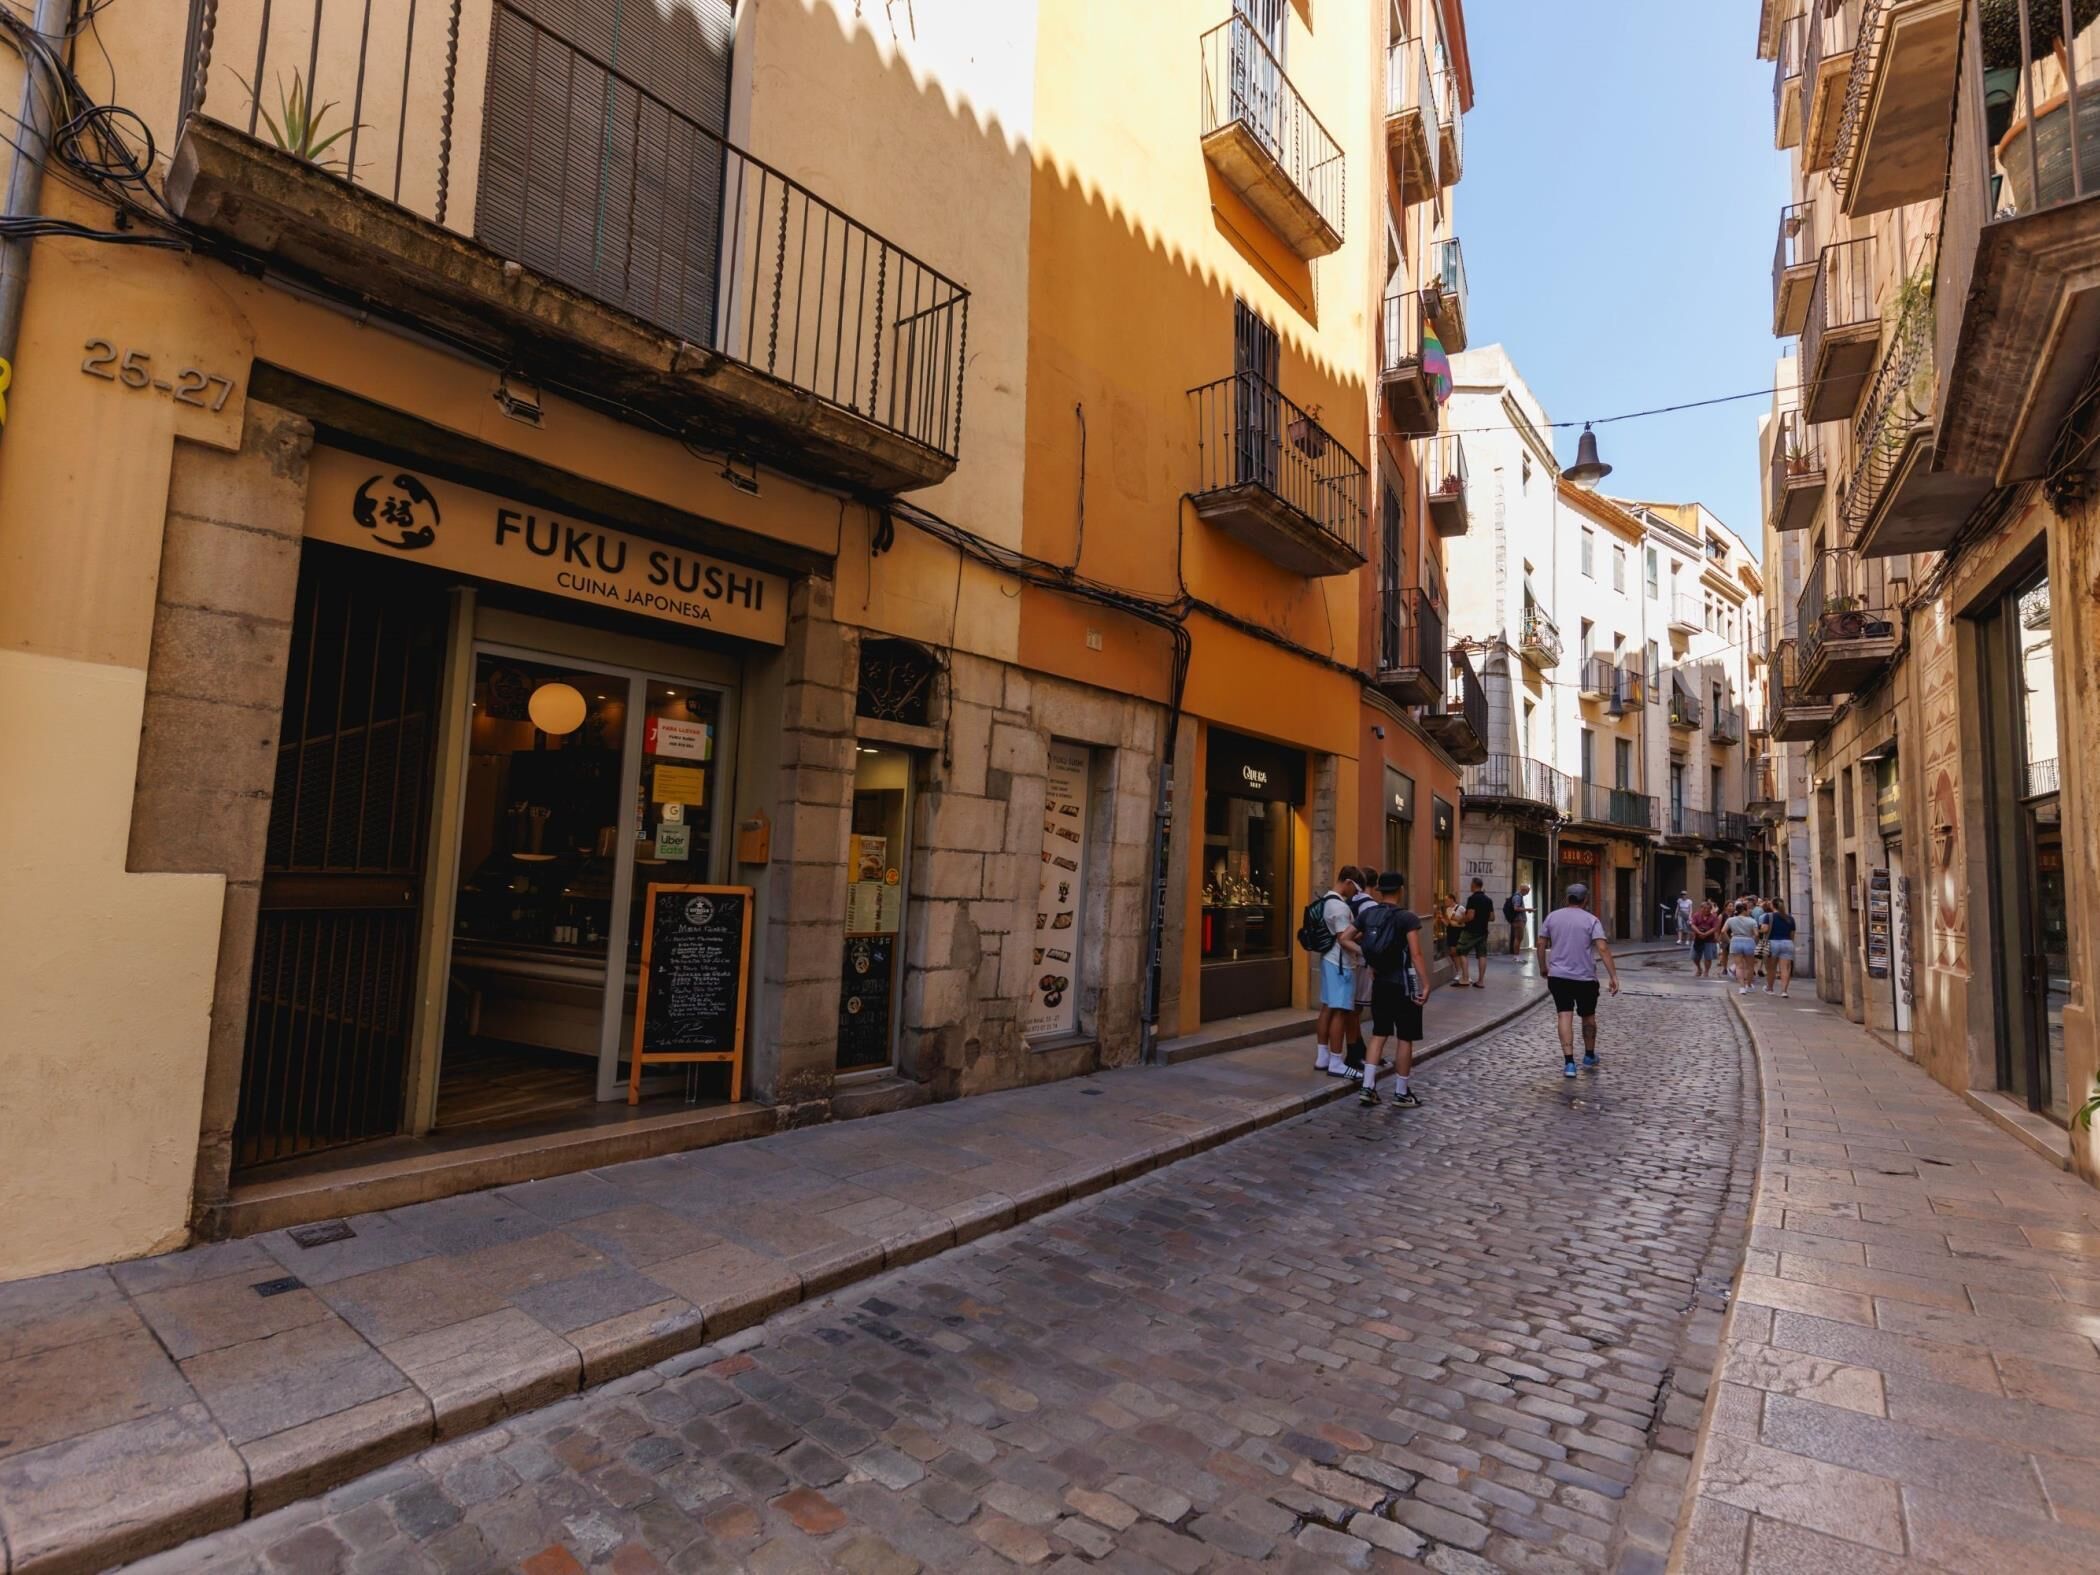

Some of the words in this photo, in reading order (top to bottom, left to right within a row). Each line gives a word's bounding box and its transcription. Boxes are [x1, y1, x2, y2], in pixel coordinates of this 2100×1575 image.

[82, 337, 234, 413] 25-27
[495, 508, 628, 574] FUKU
[647, 551, 764, 612] SUSHI
[557, 572, 620, 600] CUINA
[623, 589, 712, 622] JAPONESA
[660, 844, 684, 855] Eats
[661, 835, 685, 845] Uber
